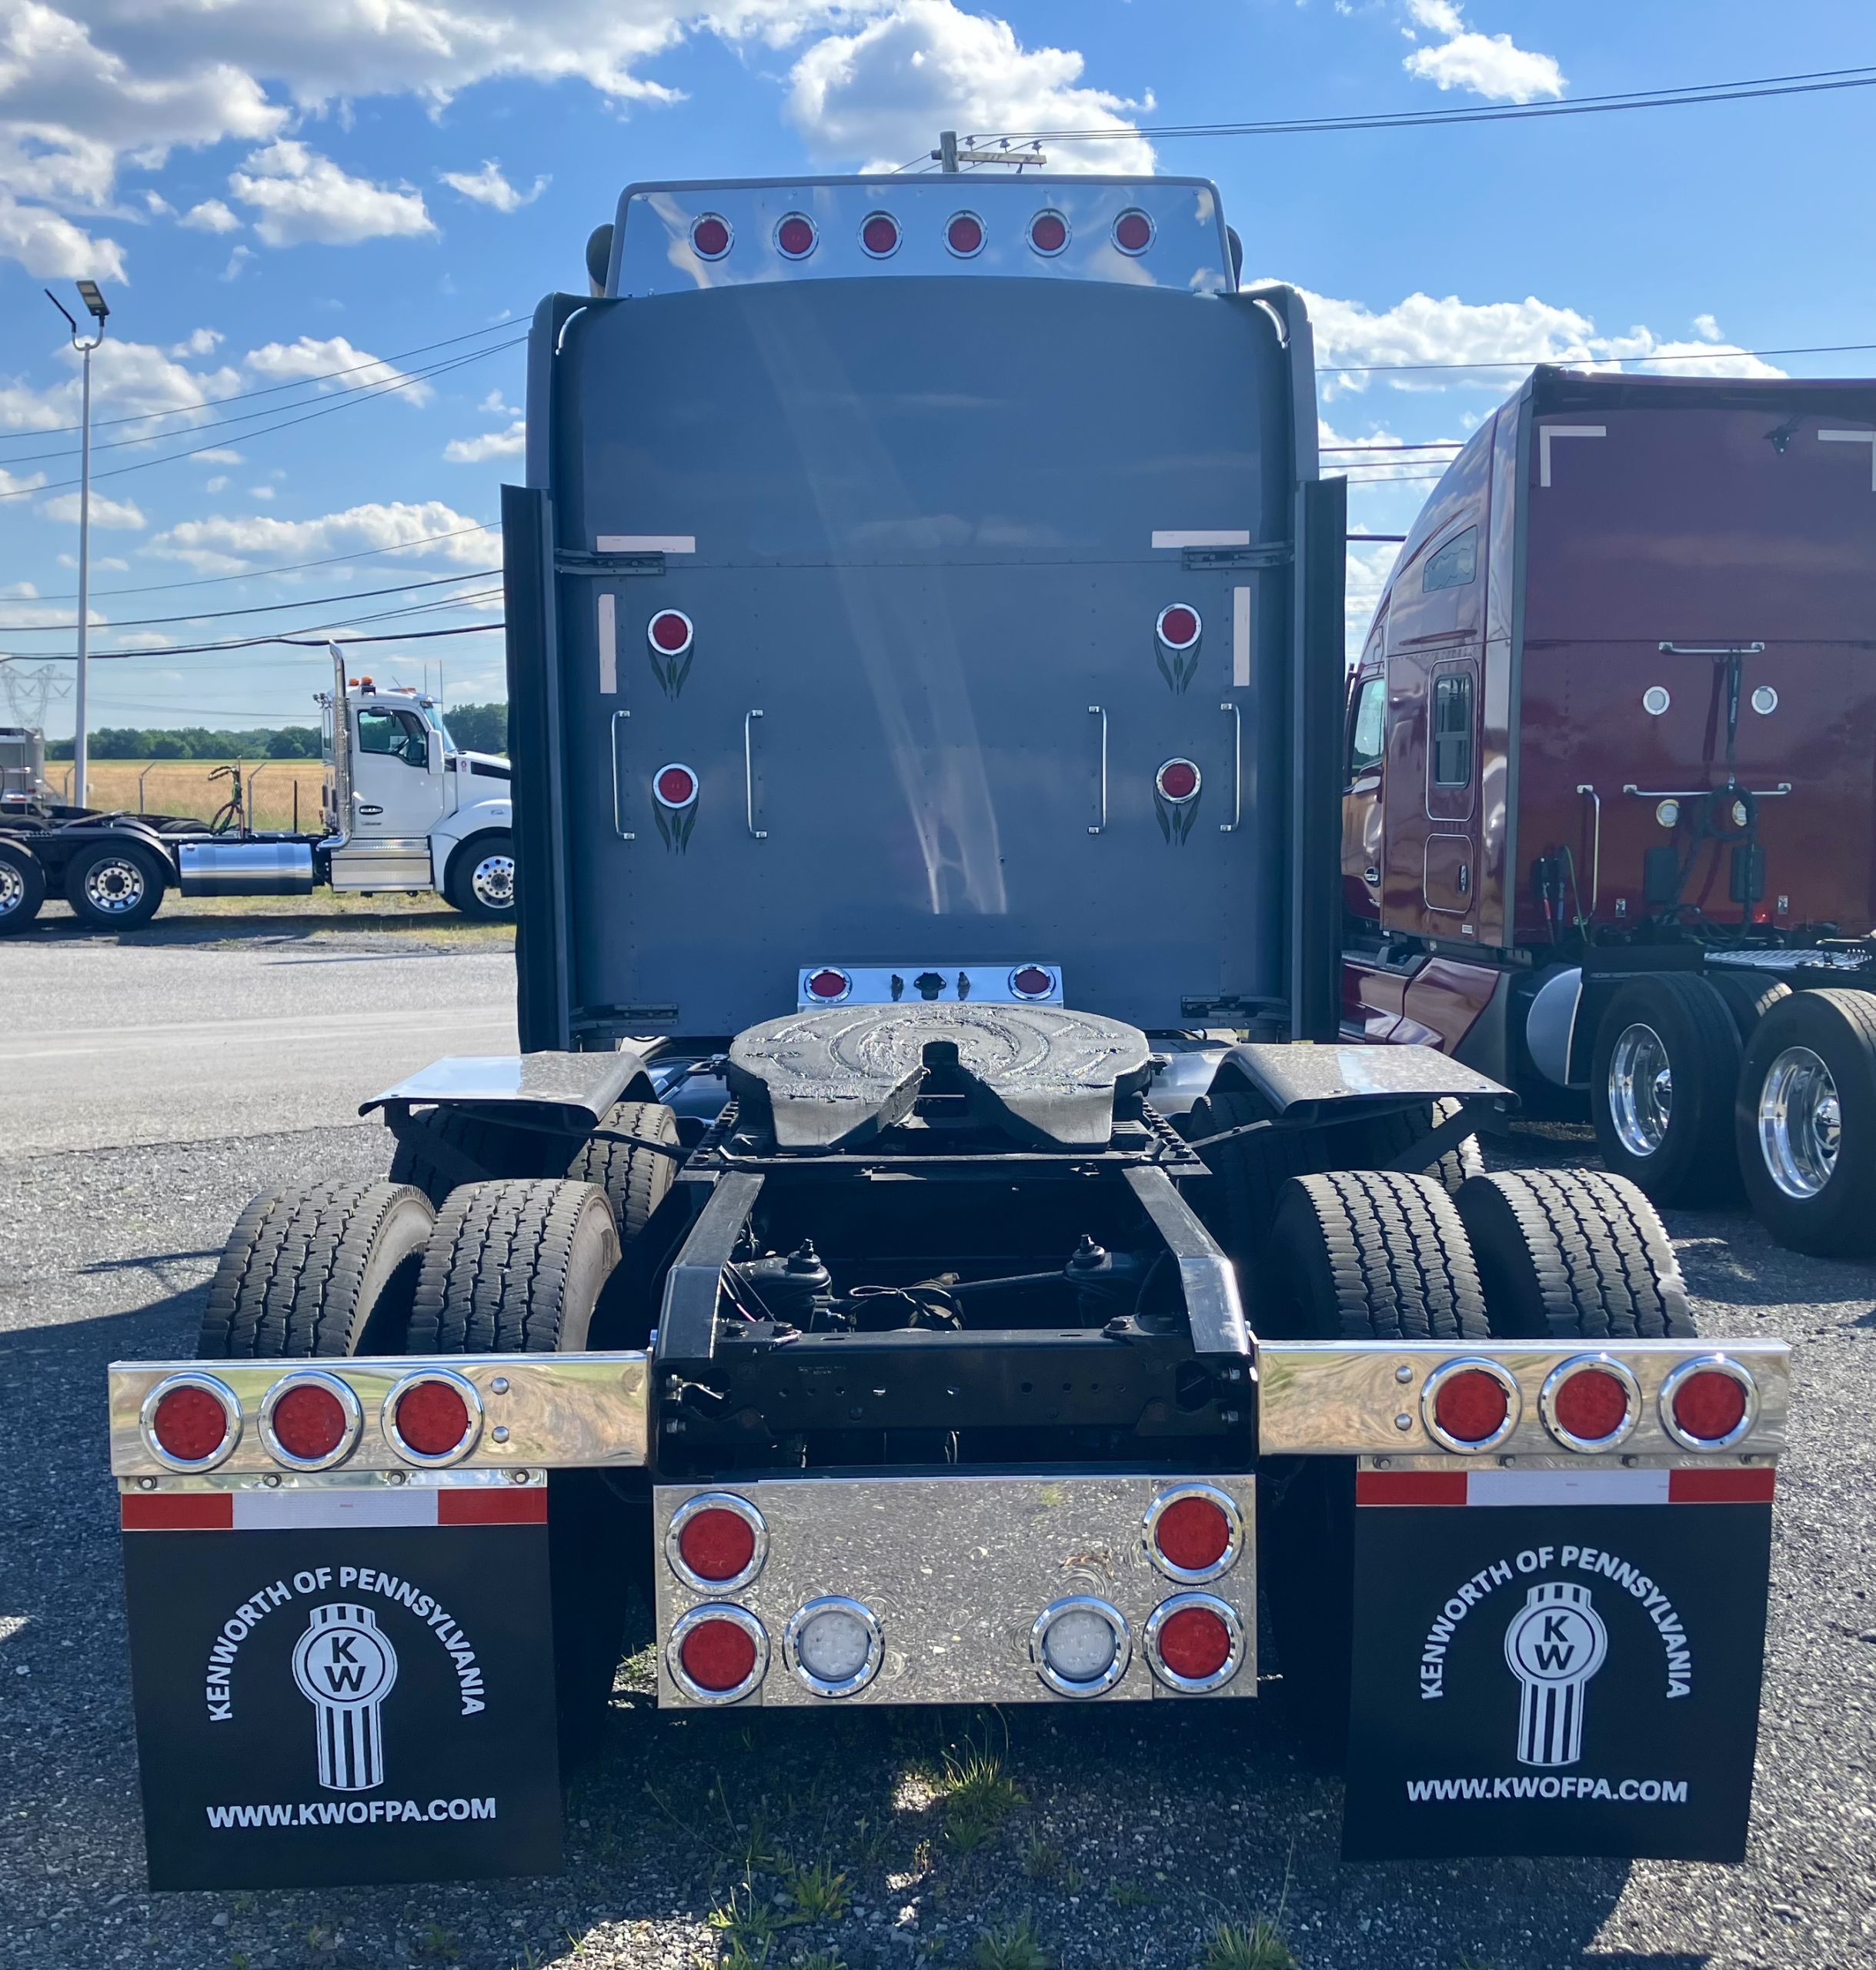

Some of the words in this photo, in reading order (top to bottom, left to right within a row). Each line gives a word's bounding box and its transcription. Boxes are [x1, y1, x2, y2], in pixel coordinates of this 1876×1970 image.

[1420, 1559, 1513, 1699] KENWORTH
[1516, 1545, 1554, 1573] OF
[1561, 1545, 1691, 1698] PENNSYLVANIA
[1543, 1615, 1570, 1643] K
[205, 1581, 292, 1721] KENWORTH
[293, 1567, 332, 1594] OF
[339, 1566, 486, 1715] PENNSYLVANIA
[331, 1636, 359, 1664] K
[1534, 1644, 1575, 1671] W
[323, 1665, 366, 1693] W
[1407, 1777, 1687, 1802] WWW.KWOFPA.COM
[206, 1797, 496, 1828] WWW.KWOFPA.COM
